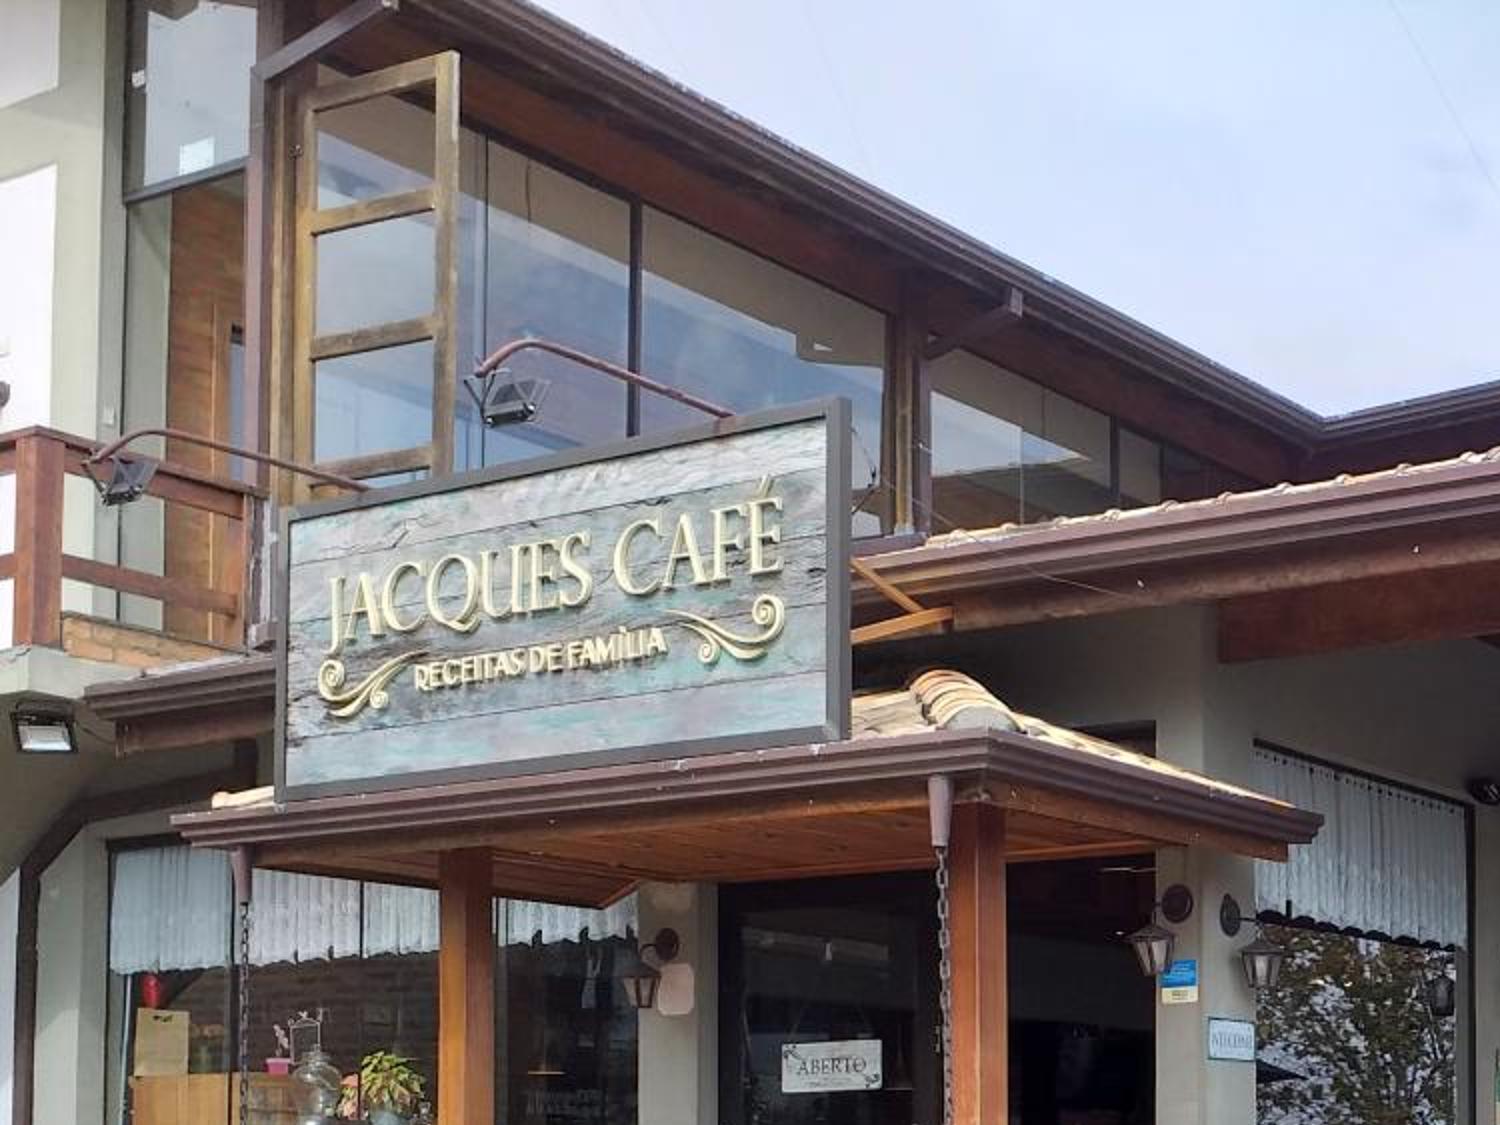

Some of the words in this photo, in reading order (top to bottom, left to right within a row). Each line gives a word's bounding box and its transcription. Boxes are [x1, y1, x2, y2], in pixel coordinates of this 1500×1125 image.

[326, 529, 594, 653] JACQUES
[611, 474, 785, 597] CAFÉ
[414, 648, 526, 692] RECEITAS
[528, 643, 564, 673] DE
[567, 626, 668, 668] FAMÍLIA
[797, 1057, 867, 1075] ABERTO
